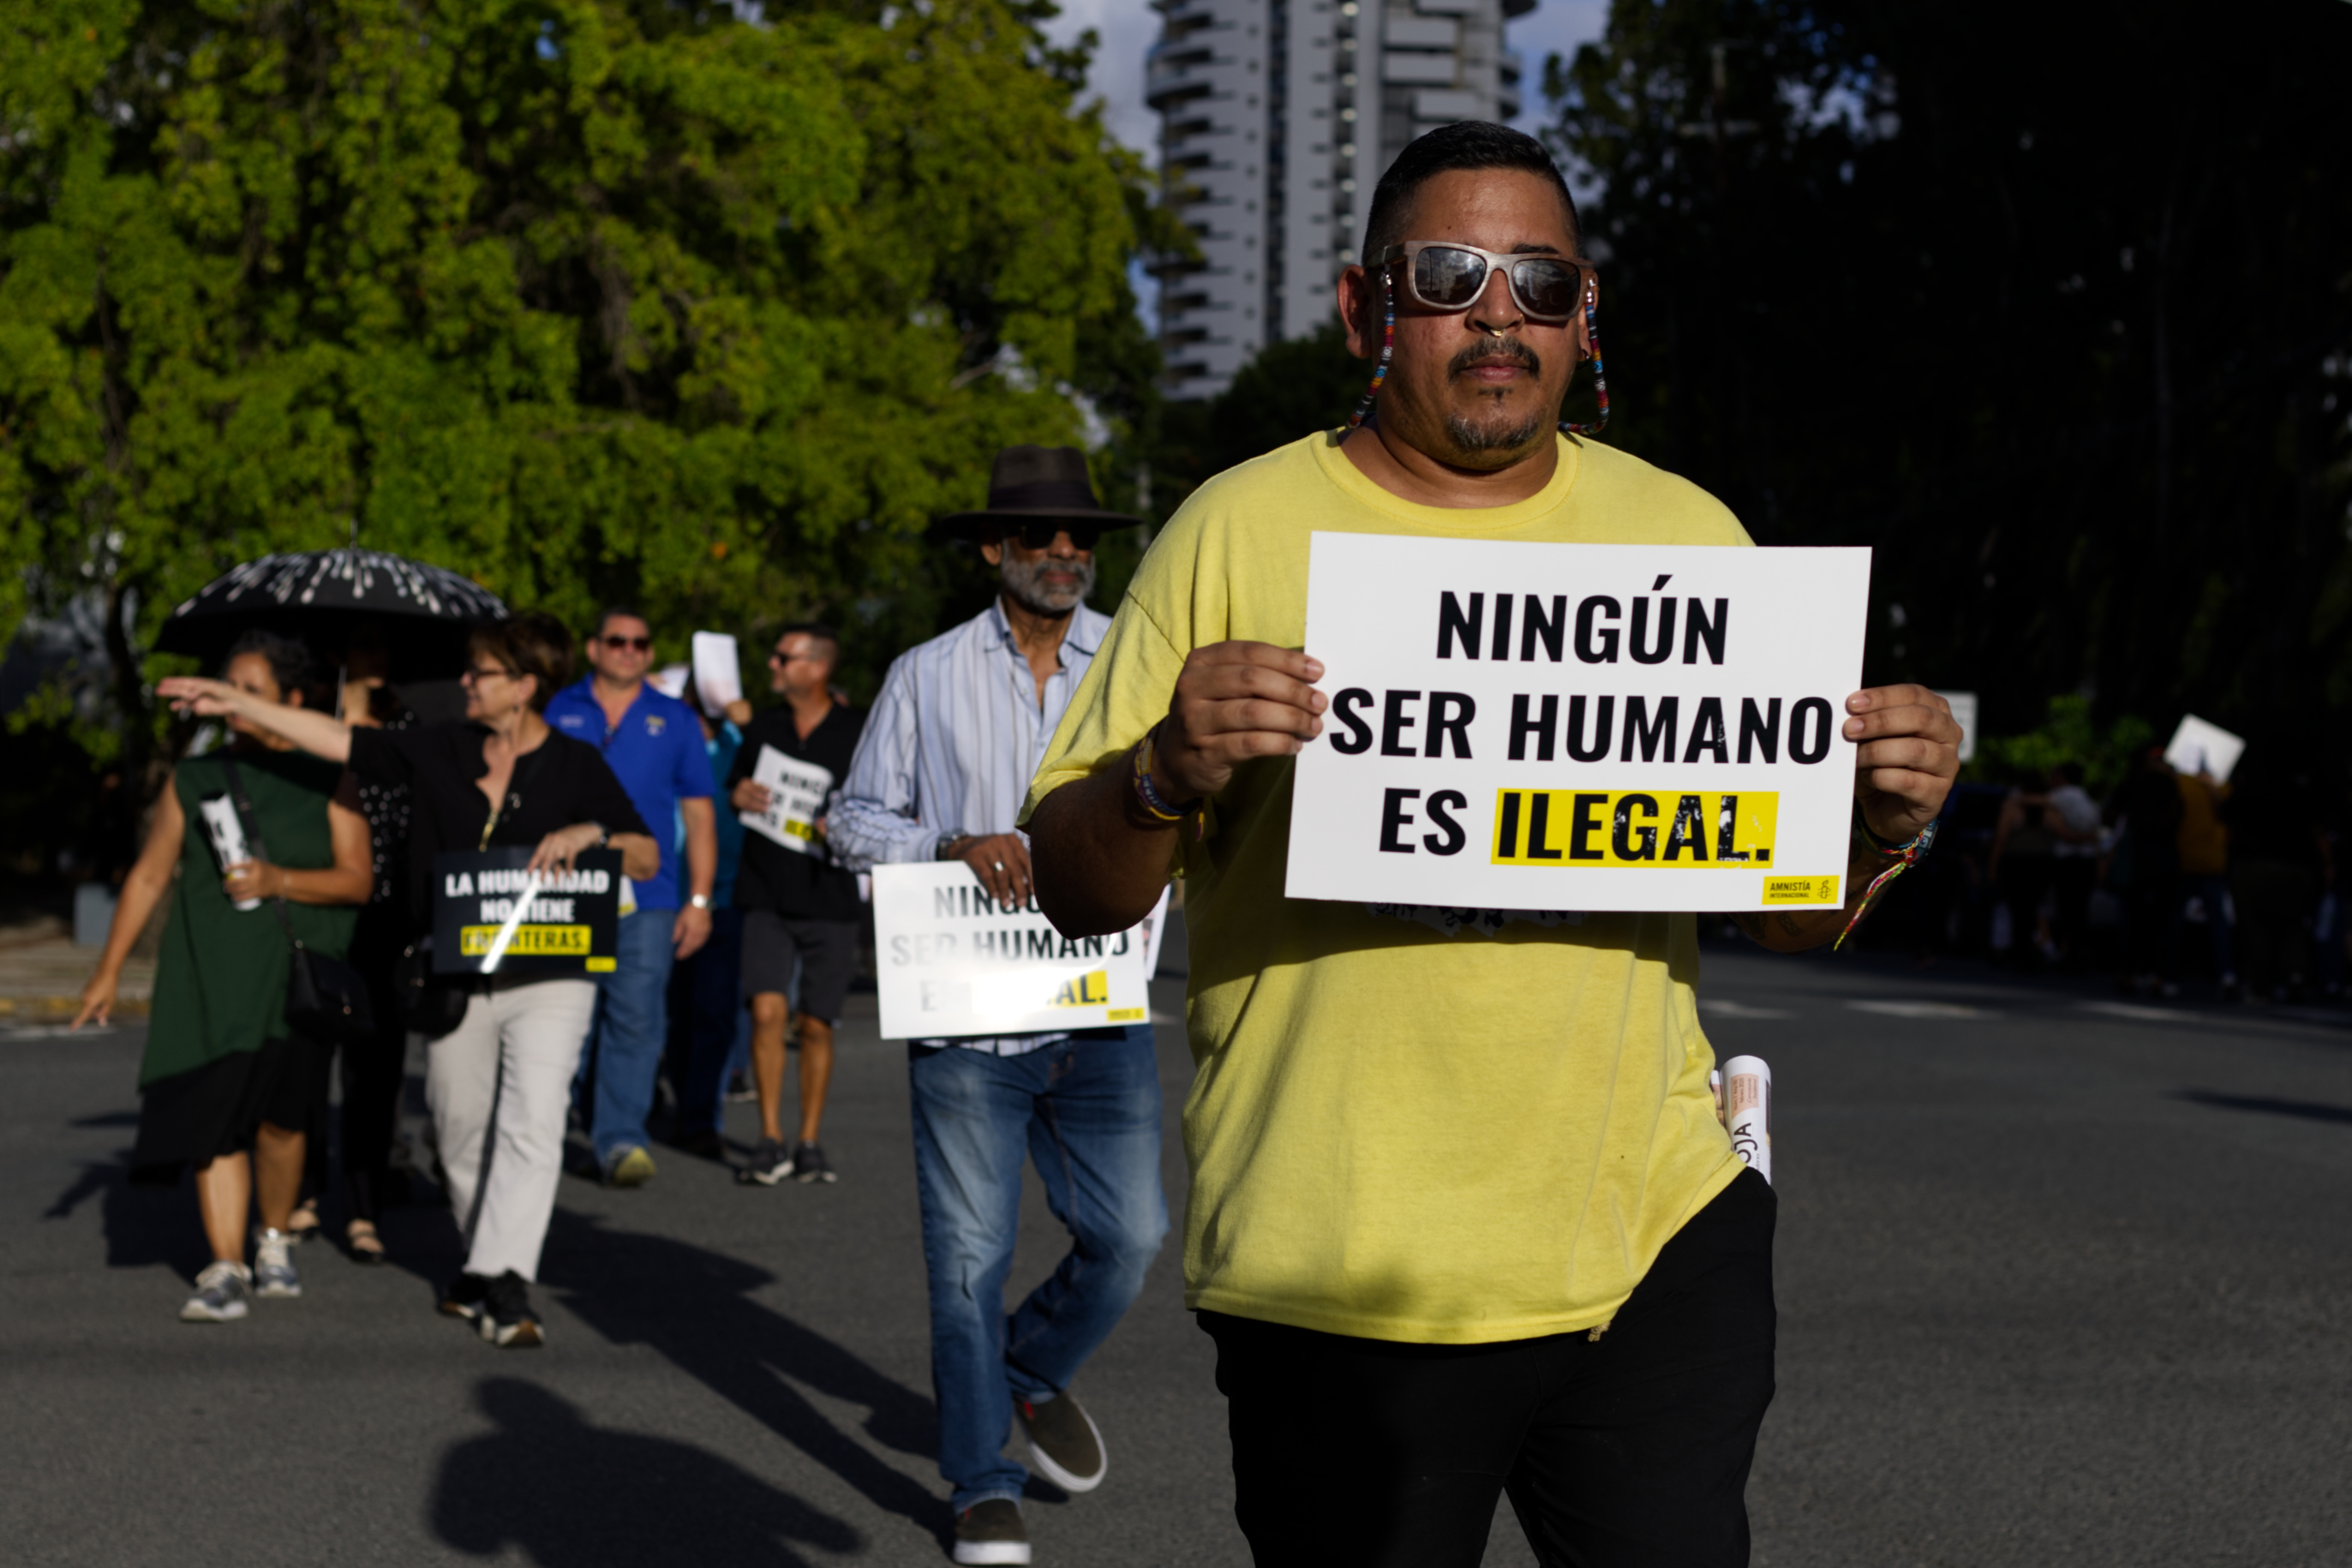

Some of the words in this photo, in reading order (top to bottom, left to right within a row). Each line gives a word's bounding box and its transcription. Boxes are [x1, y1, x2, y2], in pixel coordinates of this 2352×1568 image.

[1437, 574, 1729, 665] NINGÚN
[1330, 687, 1476, 758] SER
[1507, 694, 1833, 765] HUMANO
[1379, 787, 1468, 856] ES
[1498, 792, 1770, 861] ILEGAL.
[445, 872, 474, 897] LA
[1770, 879, 1811, 891] AMNISTÍA
